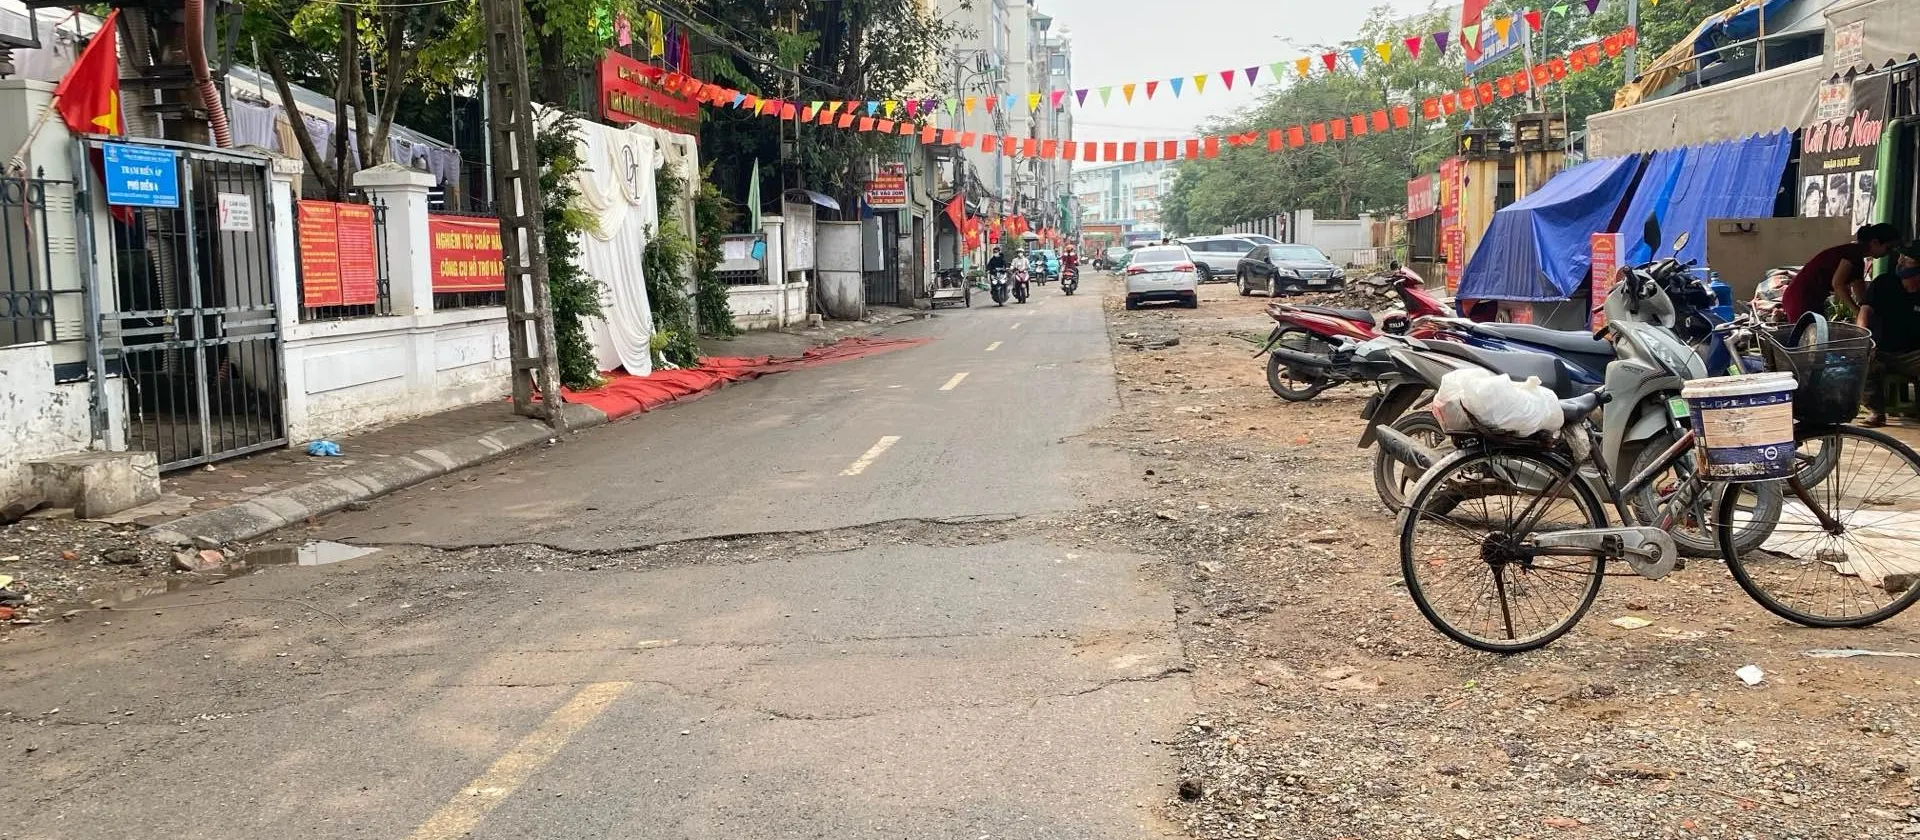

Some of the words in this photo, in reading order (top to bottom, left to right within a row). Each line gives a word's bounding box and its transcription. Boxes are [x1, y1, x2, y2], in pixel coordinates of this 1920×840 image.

[1848, 109, 1883, 148] Nam
[435, 229, 461, 250] NGHIÊM
[461, 229, 474, 250] TÚC
[474, 229, 491, 251] CHẤP
[440, 257, 458, 277] CÔNG
[459, 260, 468, 281] CỤ
[469, 255, 477, 277] HỖ
[478, 259, 490, 281] TRỢ
[490, 258, 498, 277] VÀ
